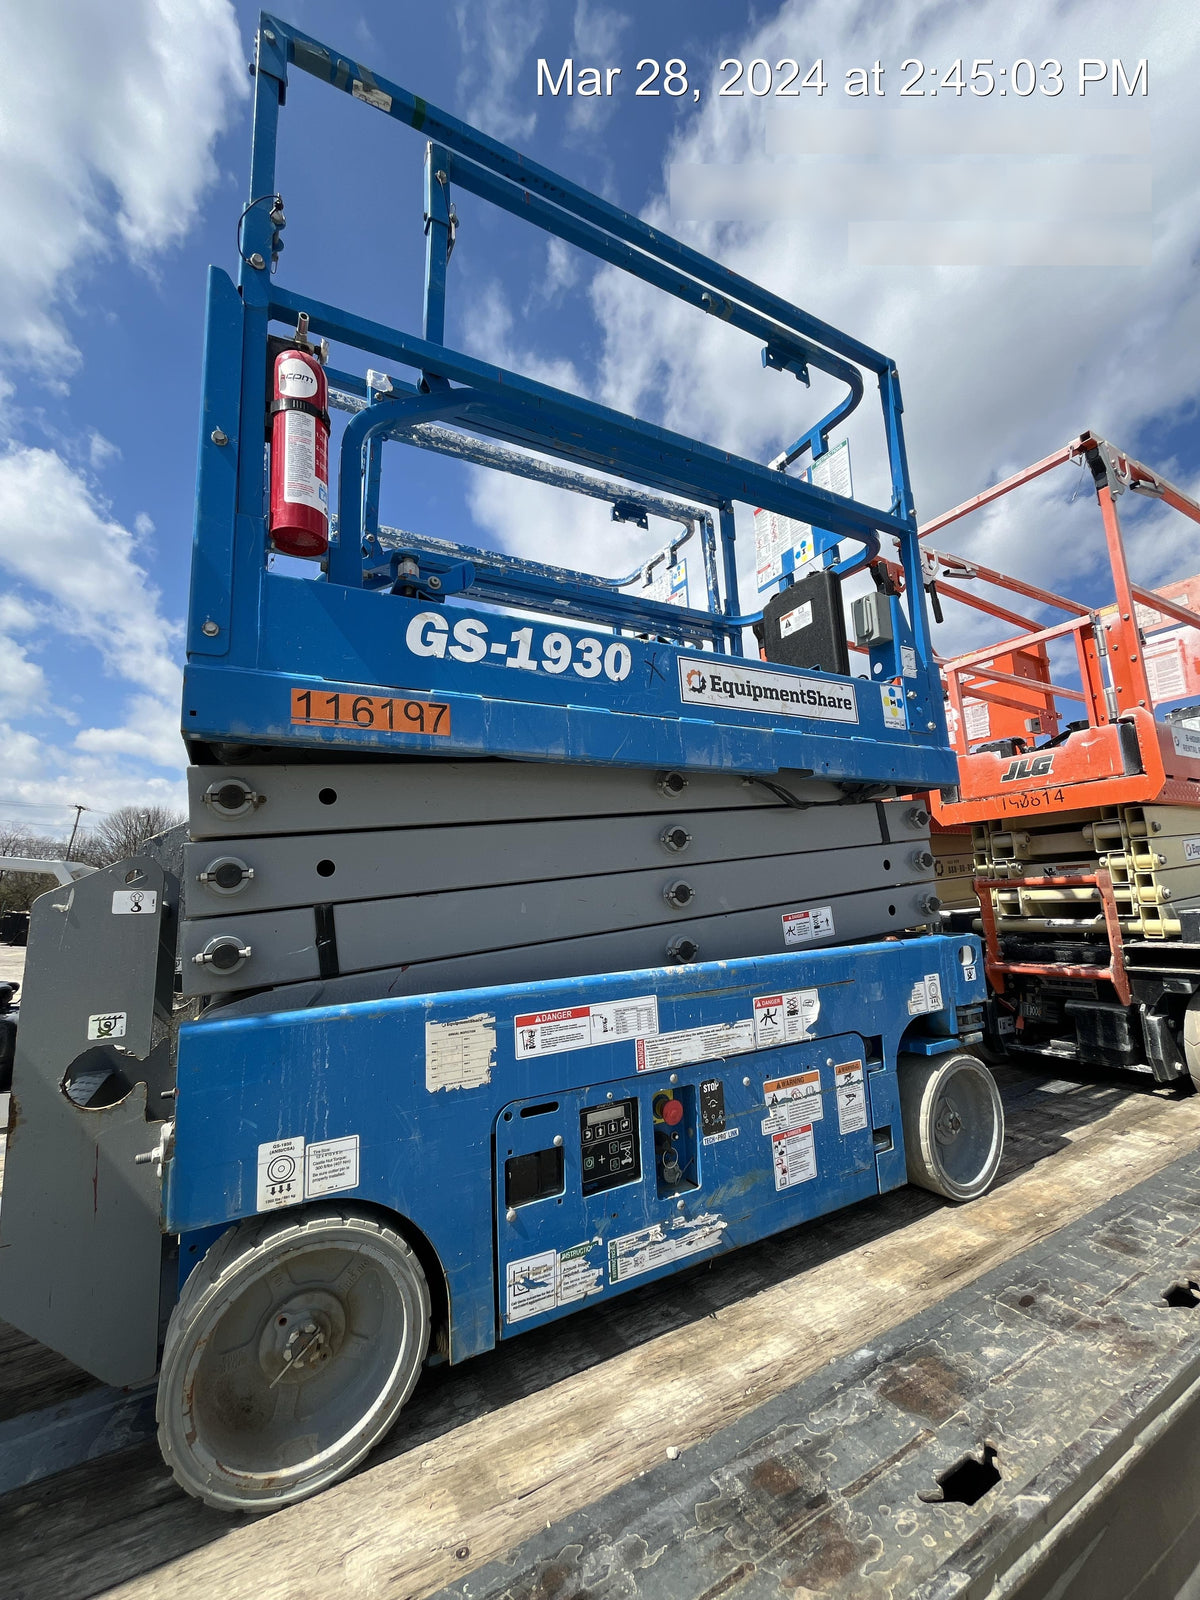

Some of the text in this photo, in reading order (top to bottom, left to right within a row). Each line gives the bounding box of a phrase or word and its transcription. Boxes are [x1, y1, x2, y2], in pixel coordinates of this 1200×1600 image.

[405, 611, 632, 682] GS-1930
[710, 674, 852, 711] EquipmentShare
[296, 690, 449, 733] 116197
[1000, 754, 1054, 783] JLG
[761, 998, 781, 1006] DANGER
[541, 1011, 573, 1022] DANGER
[637, 1040, 645, 1065] DANGER
[703, 1082, 720, 1093] STOP
[781, 1076, 805, 1087] WARNING
